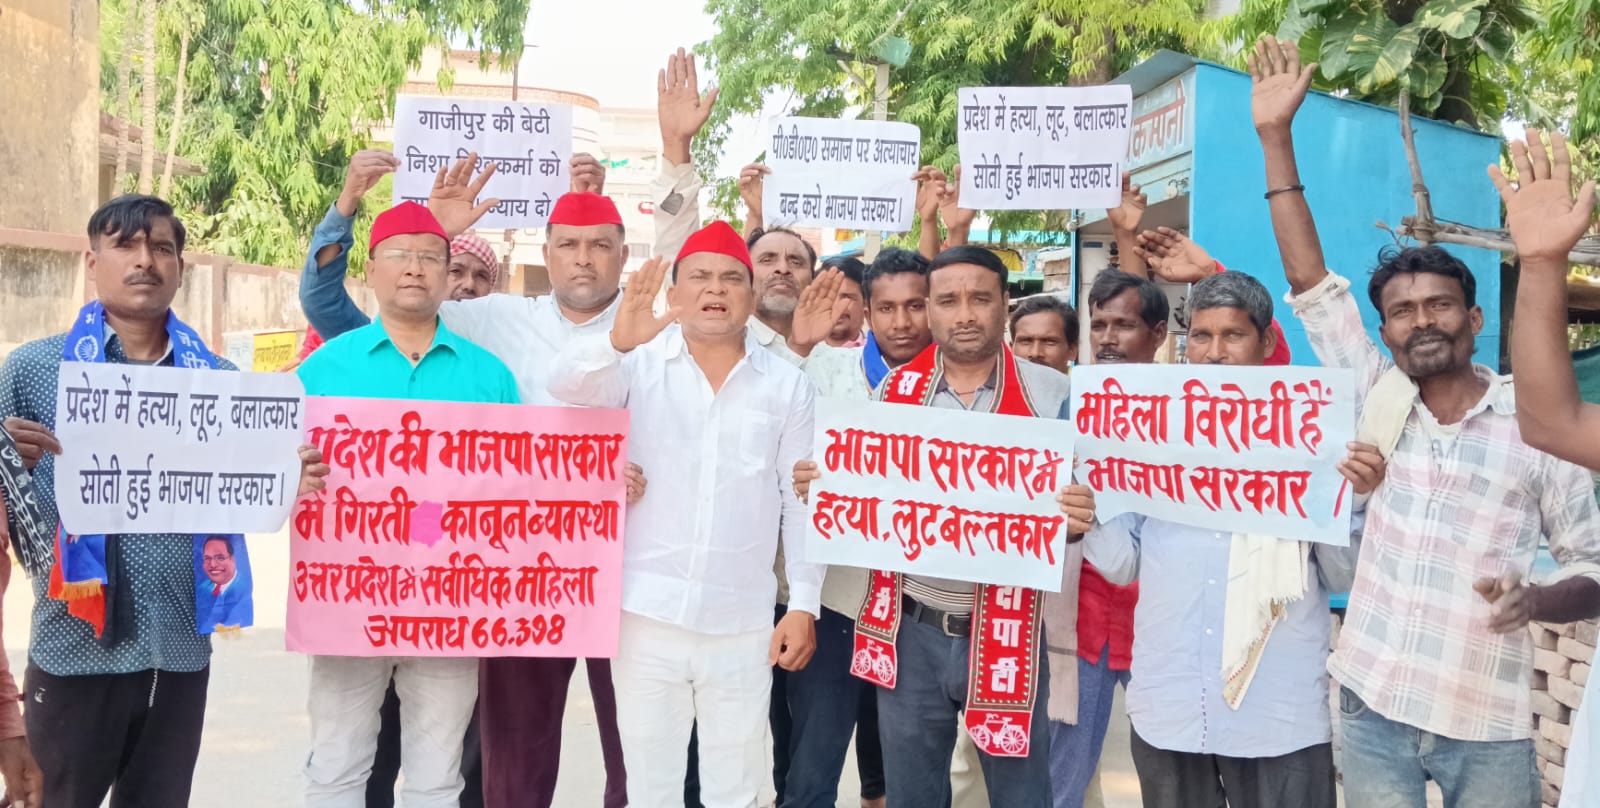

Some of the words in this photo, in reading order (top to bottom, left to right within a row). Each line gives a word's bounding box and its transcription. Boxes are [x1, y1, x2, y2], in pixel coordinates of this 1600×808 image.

[418, 104, 486, 140] गाजीपुर
[492, 106, 515, 133] की
[521, 107, 550, 134] बेटी
[964, 94, 991, 131] प्रदेश
[994, 93, 1006, 131] में
[1010, 105, 1041, 137] हत्या,
[1046, 105, 1069, 141] लूट,
[1073, 103, 1128, 131] बलात्कार
[406, 145, 450, 173] निशा
[539, 150, 561, 177] को
[821, 136, 853, 164] समाज
[856, 138, 871, 163] पर
[873, 138, 918, 166] अत्याचार
[973, 153, 1001, 189] सोती
[1006, 152, 1023, 200] हुई
[1027, 164, 1065, 189] भाजपा
[535, 192, 552, 217] दो
[779, 192, 800, 219] बन्द
[802, 183, 822, 219] करो
[825, 194, 858, 221] भाजपा
[66, 371, 109, 424] प्रदेश
[115, 374, 132, 424] में
[137, 391, 182, 436] हत्या,
[190, 393, 222, 443] लूट,
[231, 395, 300, 431] बलात्कार
[1076, 377, 1172, 445] महिला
[1180, 378, 1297, 454] विरोधी
[389, 411, 435, 475] की
[438, 430, 533, 477] भाजपा
[534, 433, 625, 482] सरकार
[825, 428, 925, 482] भाजपा
[927, 438, 1040, 500] सरकार
[1032, 449, 1064, 494] में
[79, 454, 121, 505] सोती
[127, 453, 154, 520] हुई
[159, 470, 213, 505] भाजपा
[1085, 456, 1187, 505] भाजपा
[1189, 466, 1312, 519] सरकार
[295, 488, 327, 542] में
[333, 485, 417, 545] गिरती
[441, 499, 530, 553] कानून
[892, 500, 945, 561] लुट
[940, 505, 1064, 565] बल्तकार
[294, 560, 343, 603] उत्तर
[344, 556, 399, 607] प्रदेश
[398, 567, 421, 600] में
[420, 551, 512, 609] सर्वाधिक
[515, 552, 599, 608] महिला
[365, 615, 469, 651] अपराध
